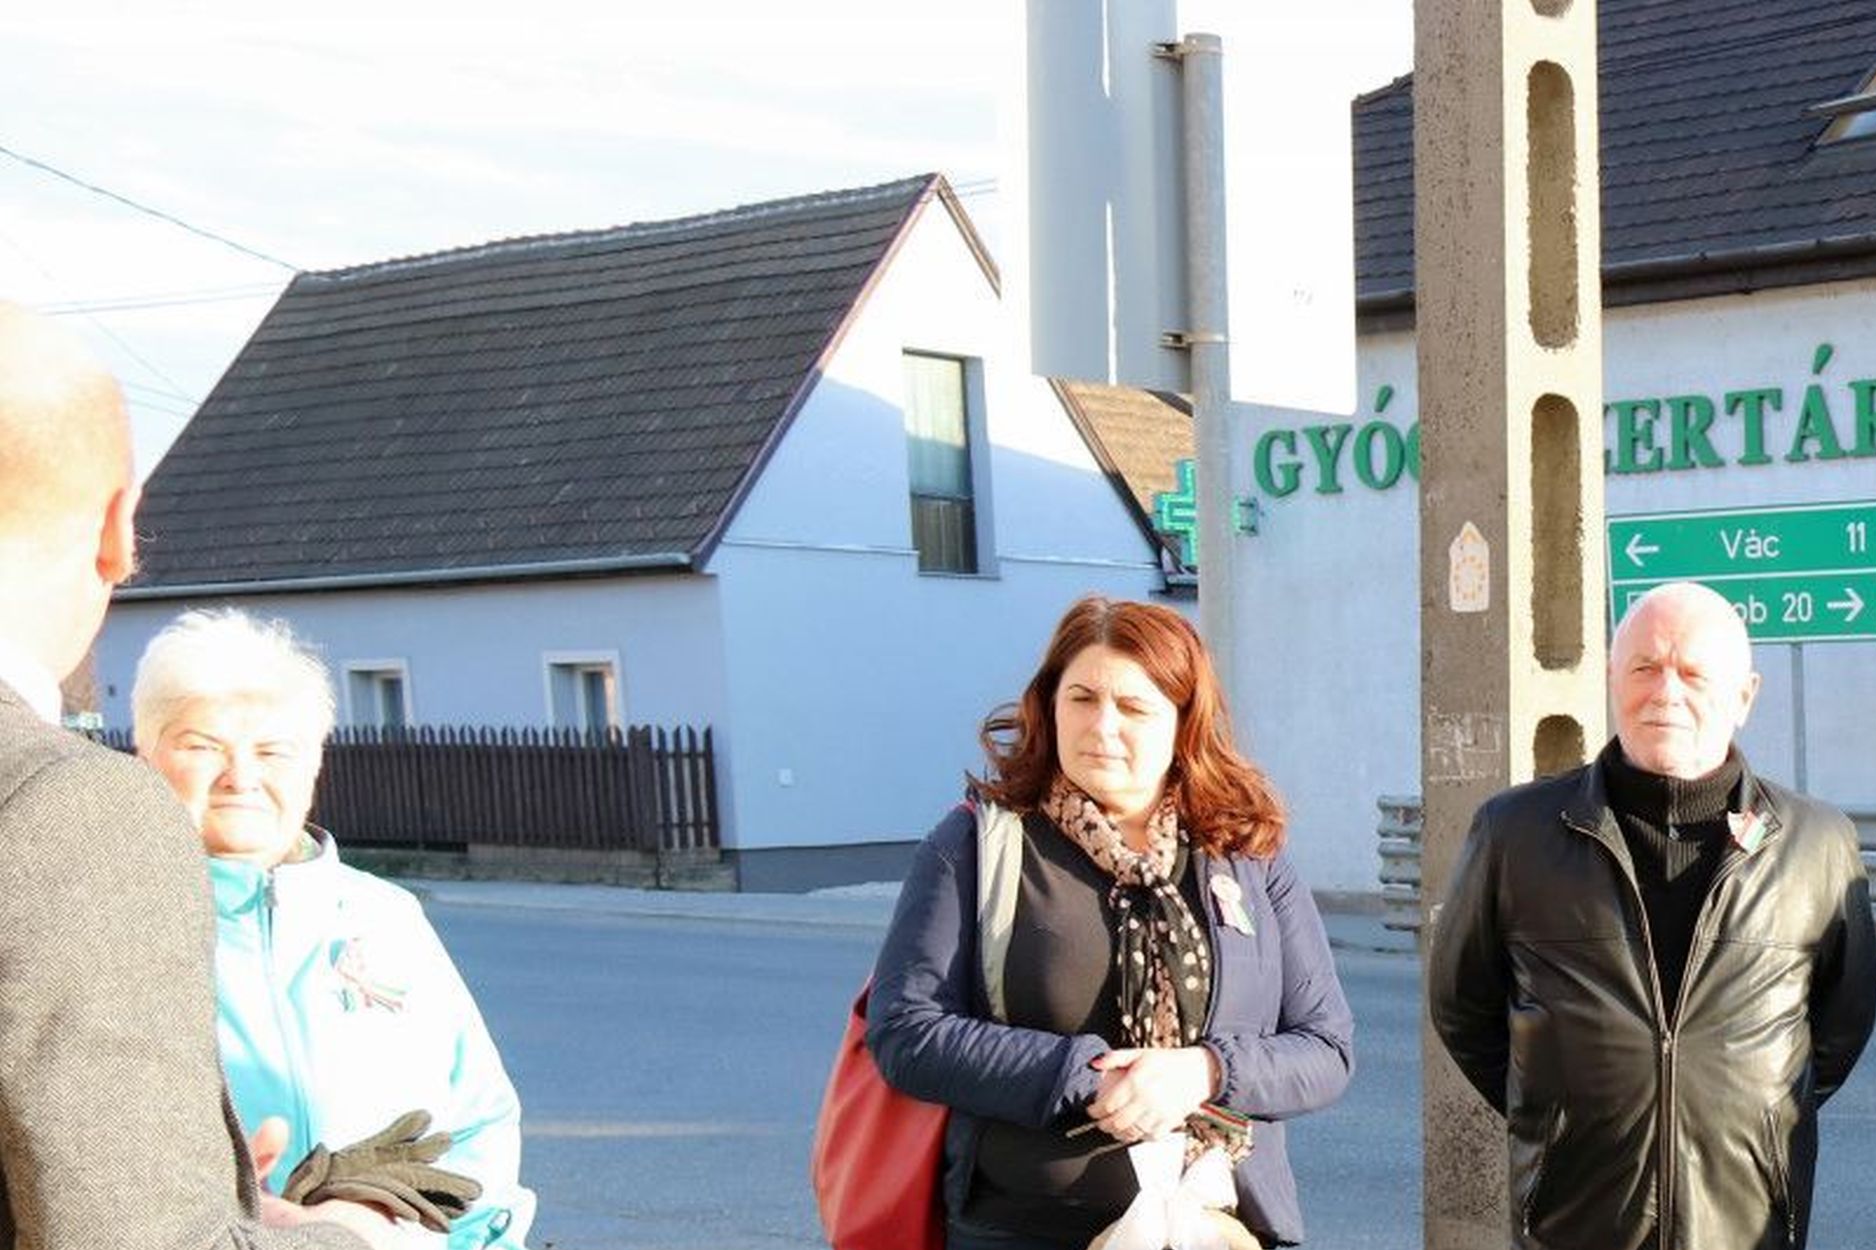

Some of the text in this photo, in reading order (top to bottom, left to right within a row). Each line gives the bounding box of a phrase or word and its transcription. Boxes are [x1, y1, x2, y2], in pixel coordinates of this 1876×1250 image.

[1720, 521, 1867, 559] Vác 11
[1782, 592, 1813, 622] 20
